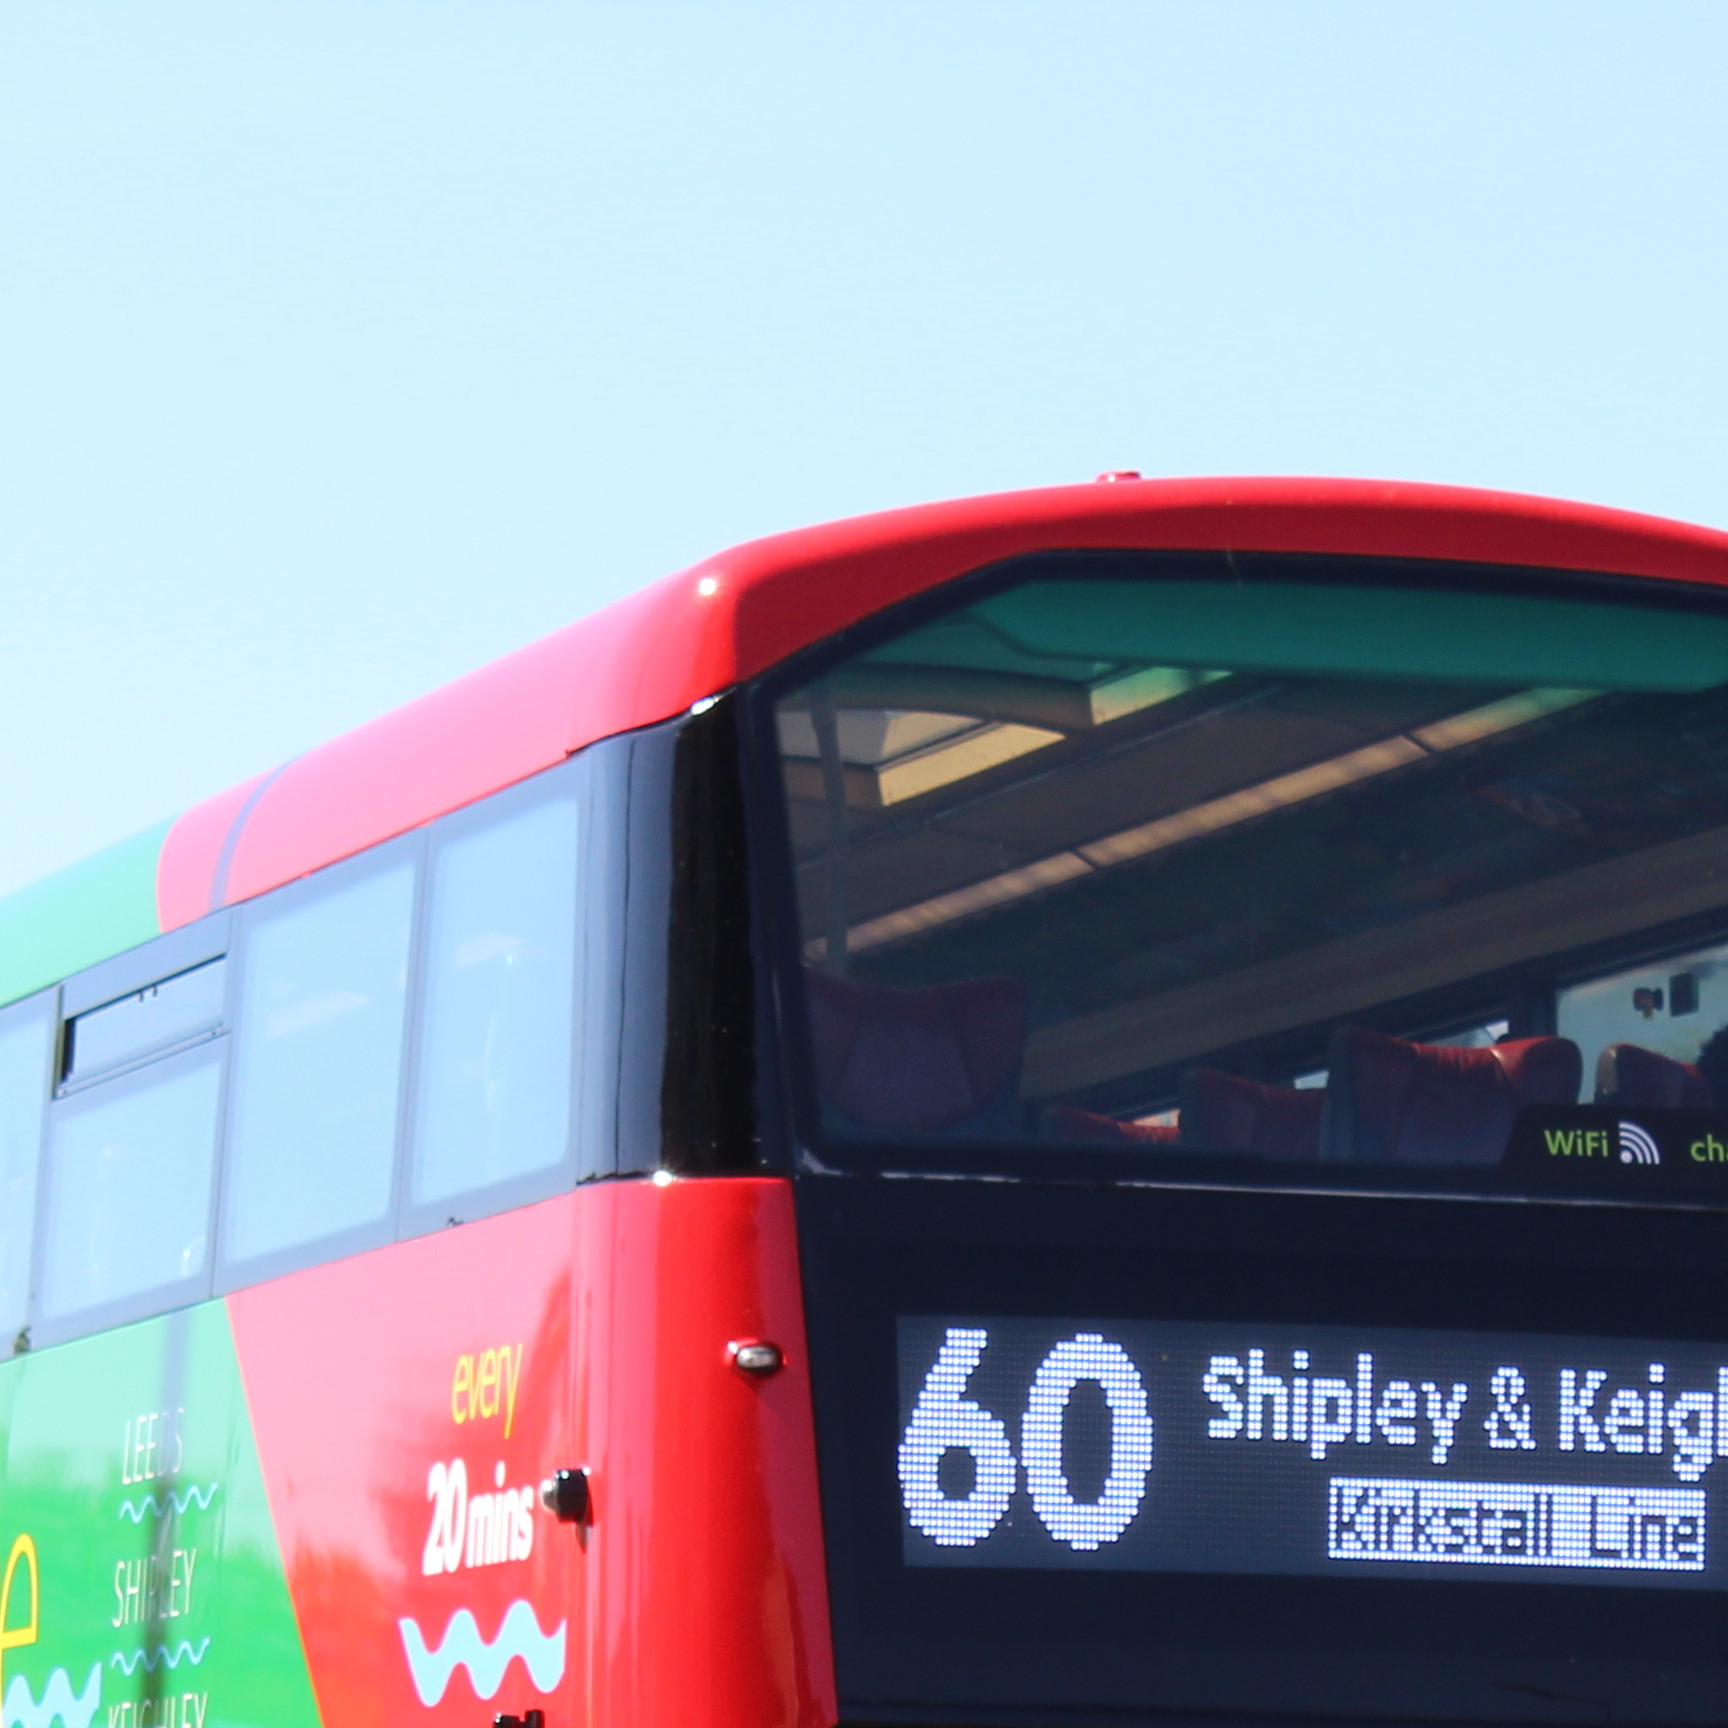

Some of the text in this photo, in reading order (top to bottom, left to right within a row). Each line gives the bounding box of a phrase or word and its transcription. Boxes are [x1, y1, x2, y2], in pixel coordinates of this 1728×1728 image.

[1544, 1126, 1610, 1159] WiFi
[451, 1342, 523, 1438] every
[122, 1408, 184, 1485] LEEDS
[897, 1327, 1154, 1551] 60
[1203, 1349, 1469, 1463] Shipley
[1483, 1367, 1536, 1452] &
[421, 1459, 534, 1576] 20 mins
[1338, 1487, 1700, 1561] Kirkstall Line
[112, 1548, 197, 1628] SHIPLEY
